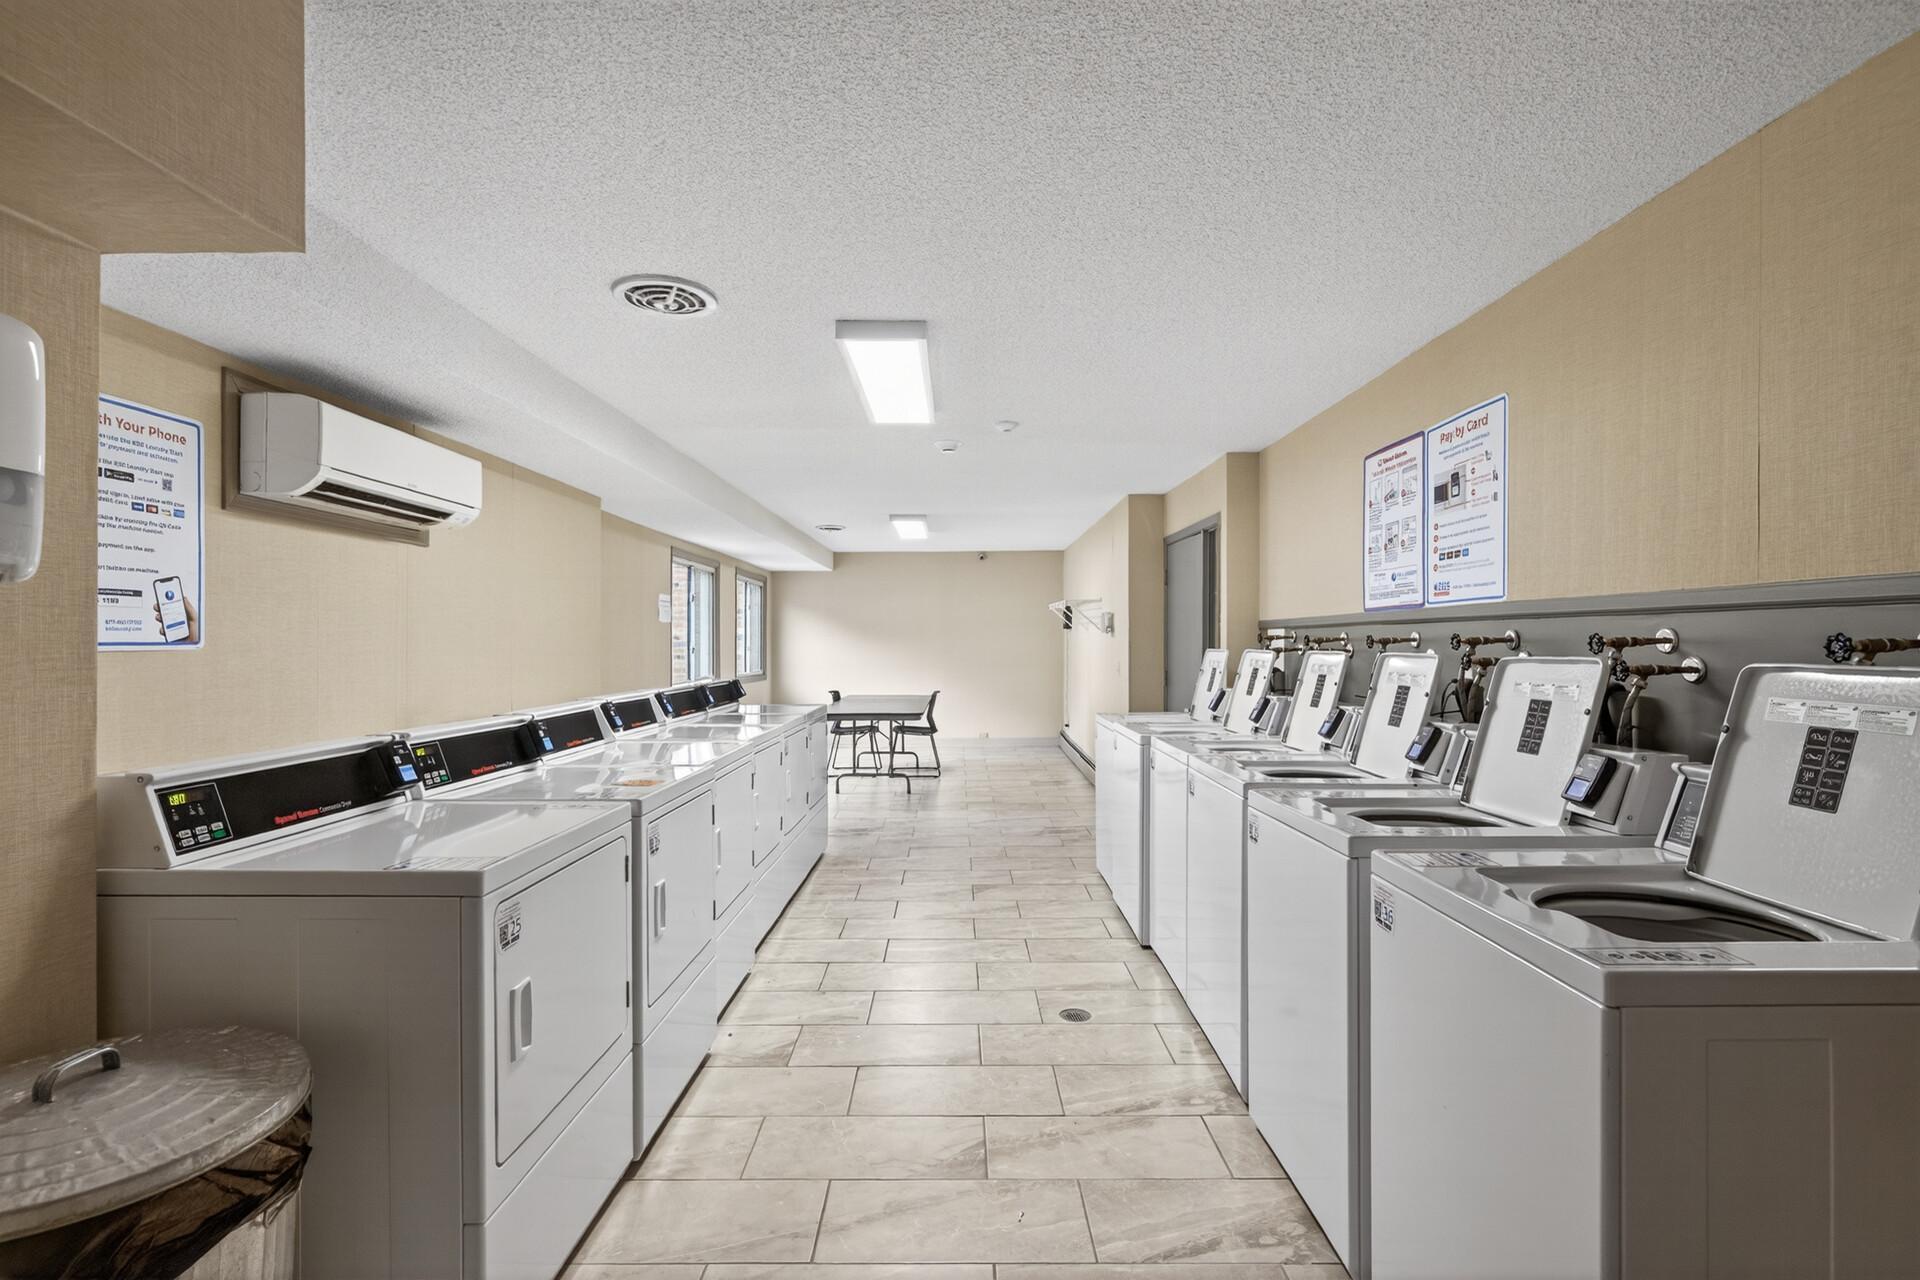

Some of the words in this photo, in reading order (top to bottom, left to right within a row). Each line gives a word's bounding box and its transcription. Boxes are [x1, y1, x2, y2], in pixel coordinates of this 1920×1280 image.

[115, 416, 145, 434] Your
[148, 426, 187, 445] Phone
[1440, 431, 1453, 444] Pay
[1455, 426, 1465, 438] by
[1466, 413, 1489, 432] Card
[510, 917, 522, 936] 25
